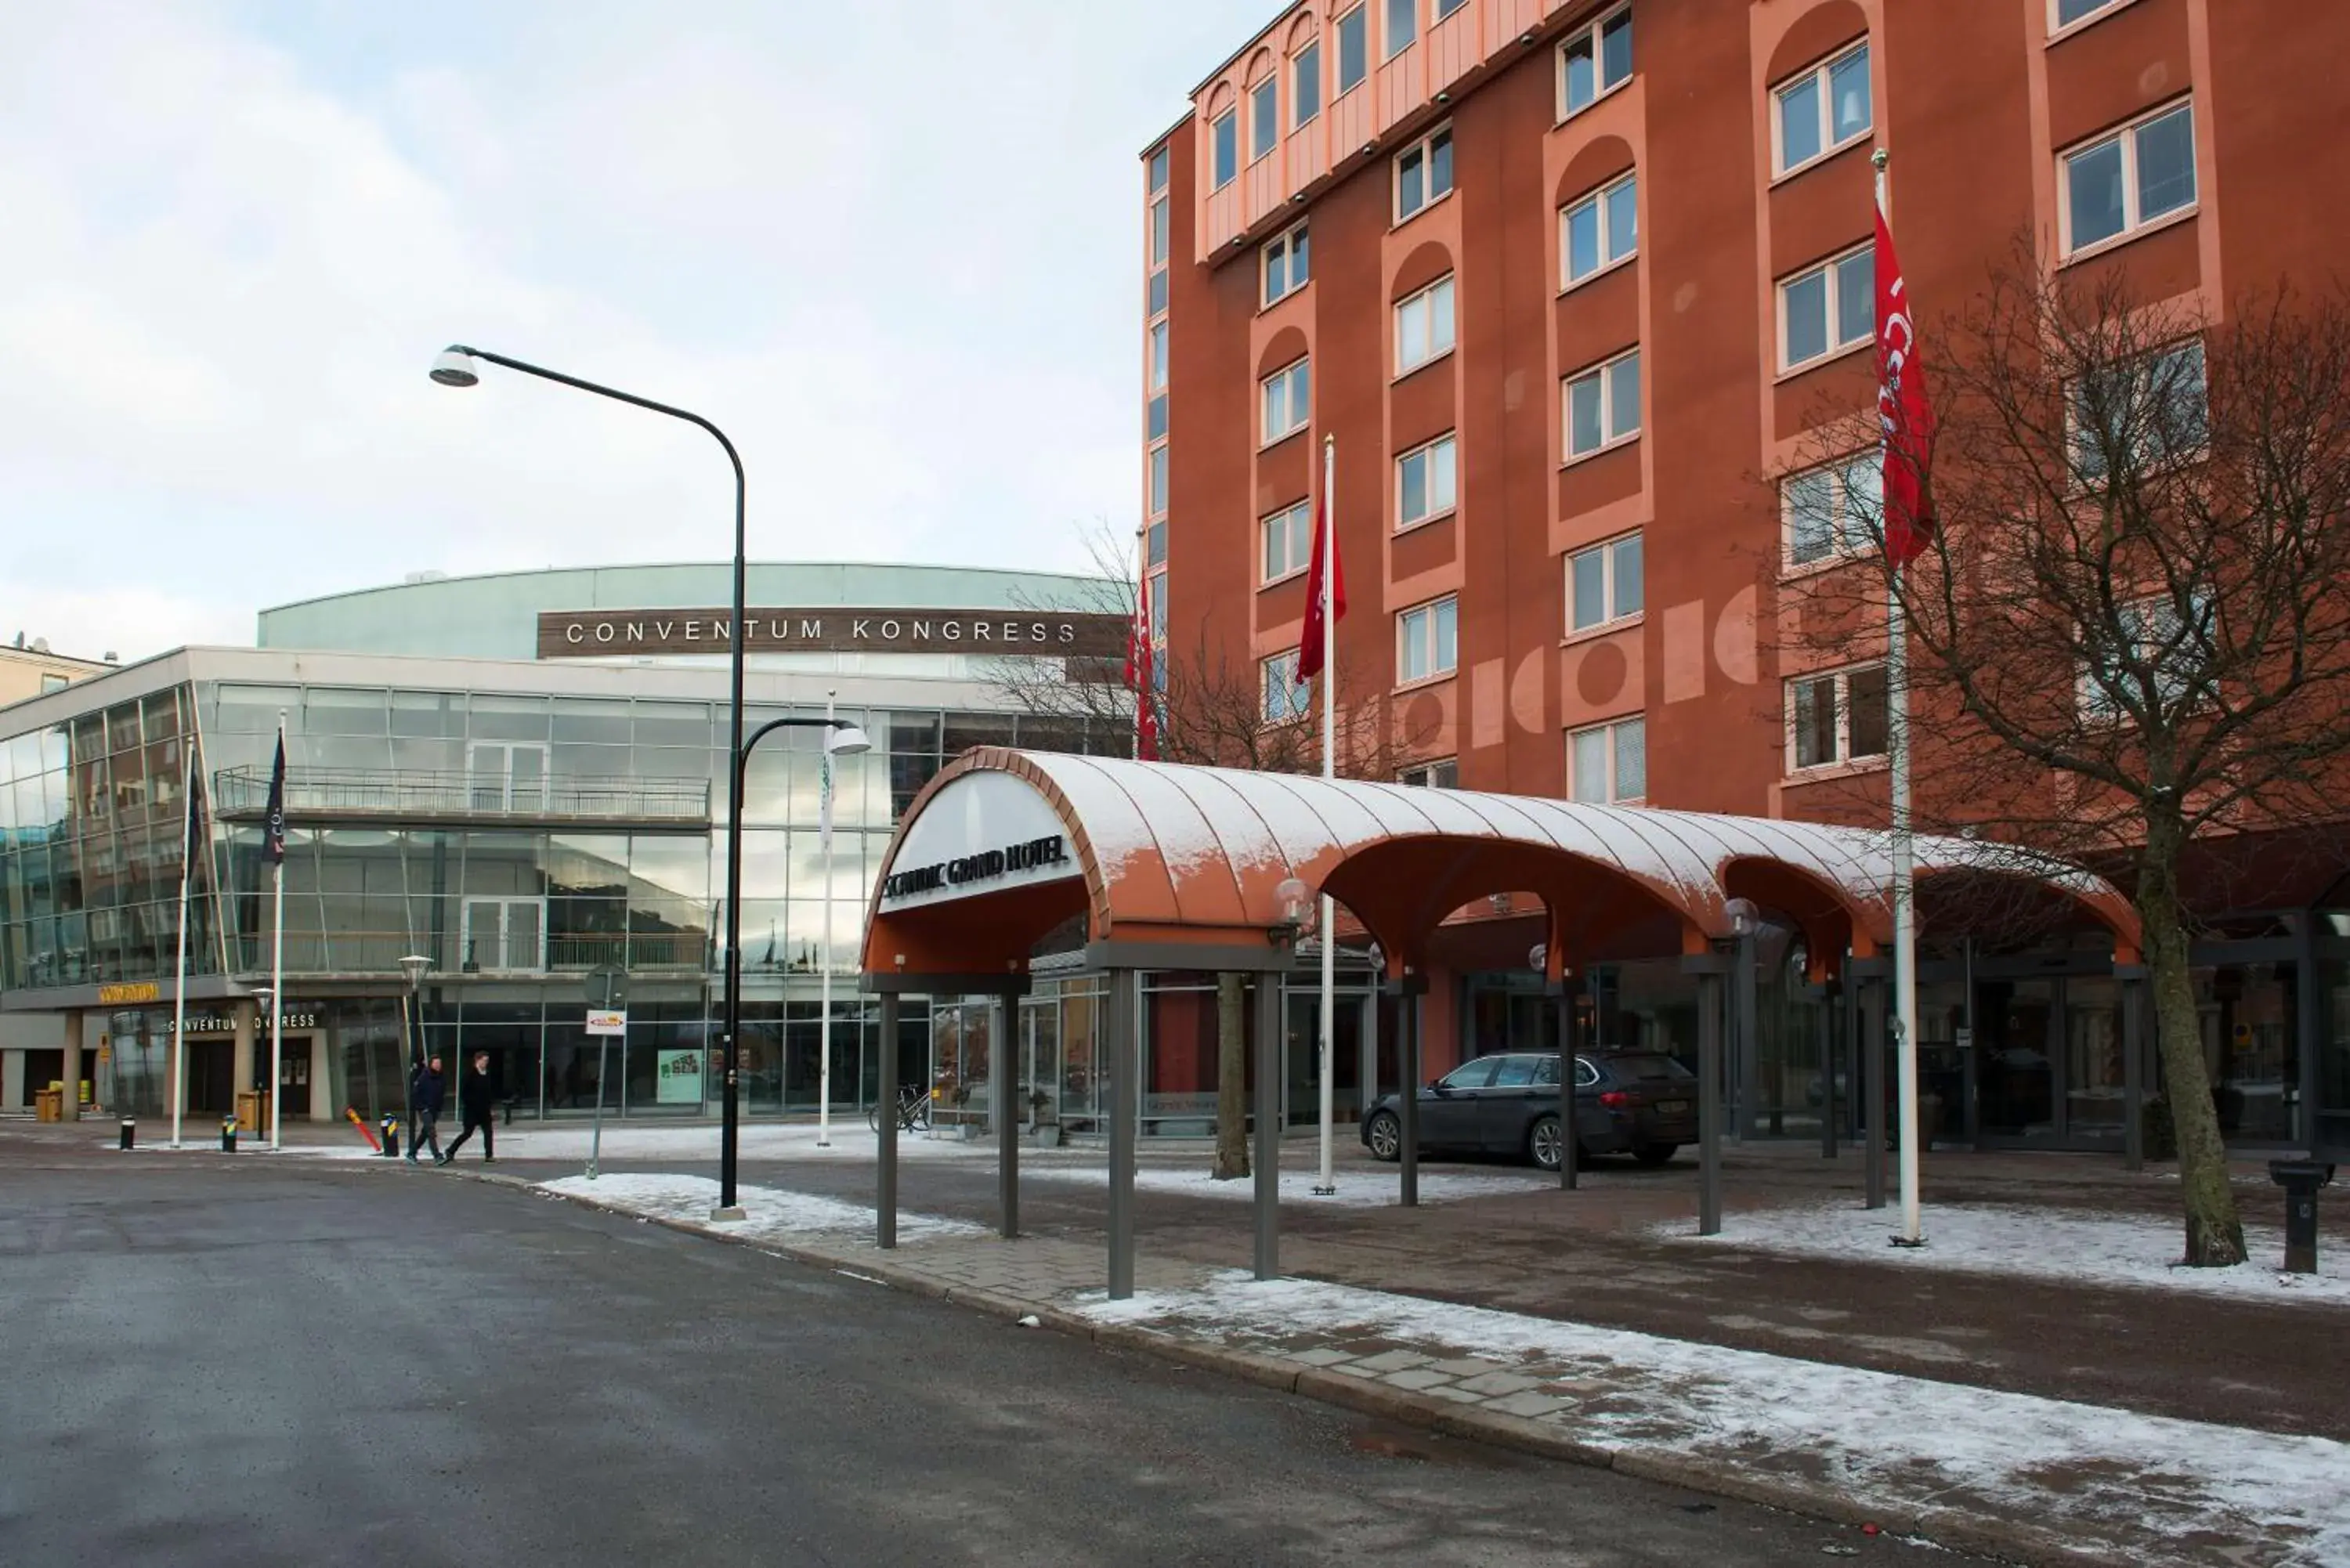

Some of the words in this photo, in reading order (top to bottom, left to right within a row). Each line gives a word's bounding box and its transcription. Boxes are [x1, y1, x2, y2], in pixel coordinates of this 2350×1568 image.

[566, 619, 822, 643] CONVENTUM
[851, 619, 1075, 643] KONGRESS
[946, 849, 1005, 884] GRAND
[1005, 834, 1068, 873] HOTEL
[168, 1016, 237, 1031] CNVENTUM
